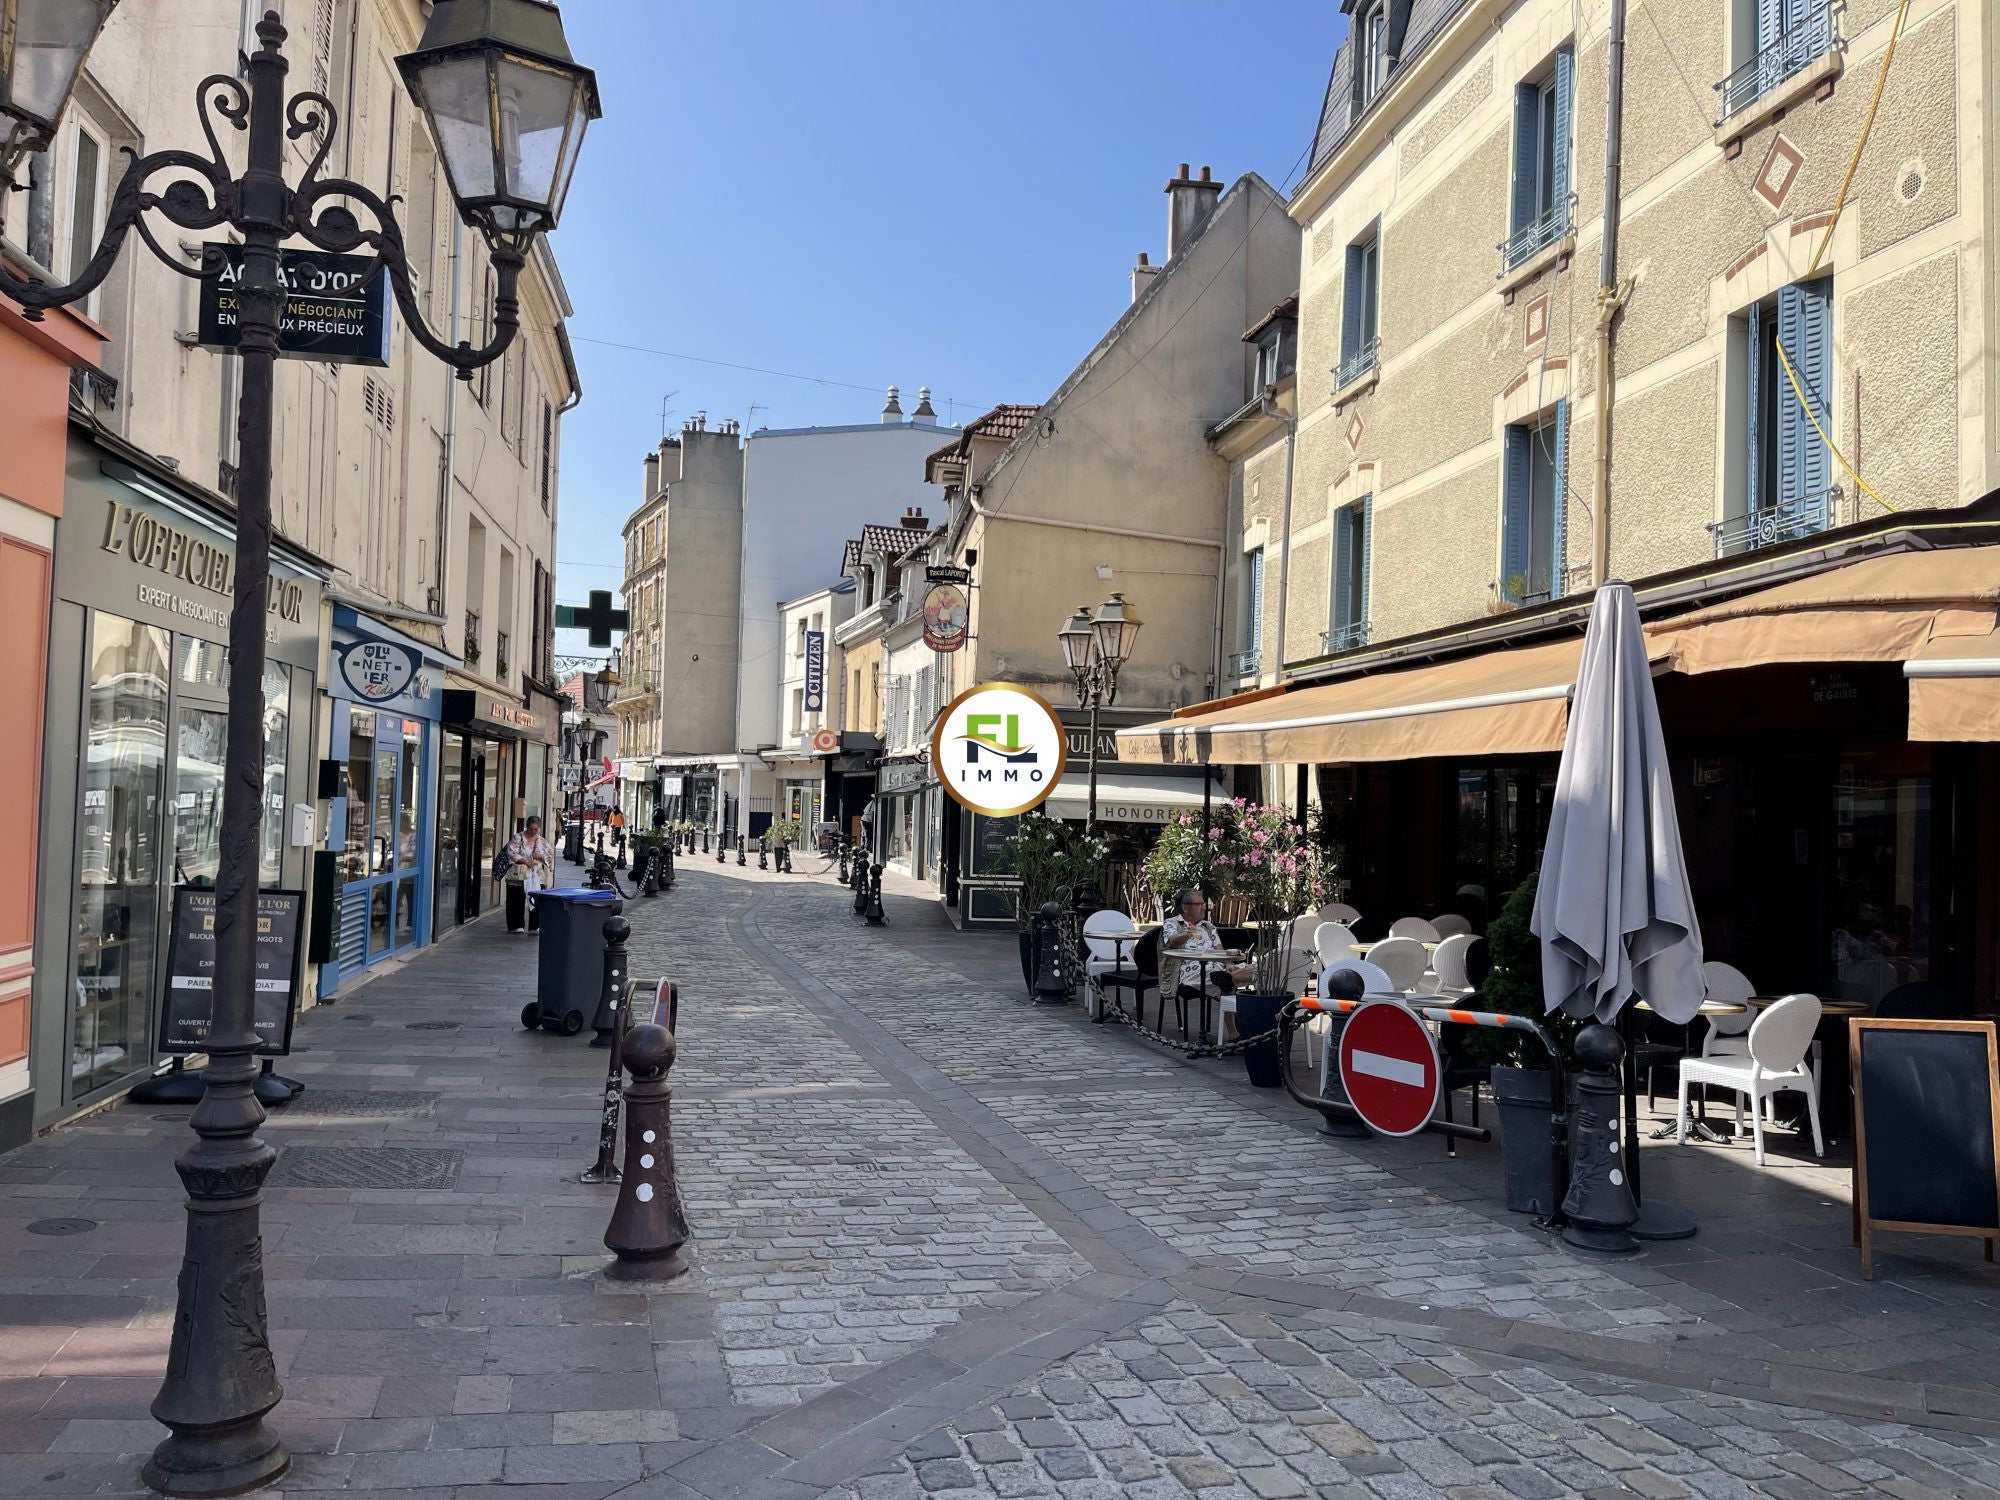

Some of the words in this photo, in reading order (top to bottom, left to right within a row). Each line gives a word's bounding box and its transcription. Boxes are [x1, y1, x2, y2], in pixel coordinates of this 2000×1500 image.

[288, 302, 365, 320] NÉGOCIANT
[218, 313, 236, 325] EN
[298, 319, 364, 336] PRÉCIEUX
[139, 584, 171, 608] EXPERT
[172, 595, 178, 612] &
[178, 597, 218, 626] NEGOCIANT
[218, 611, 228, 627] EN
[362, 659, 392, 672] NET
[808, 635, 822, 694] CITIZEN
[267, 900, 291, 909] L'OR
